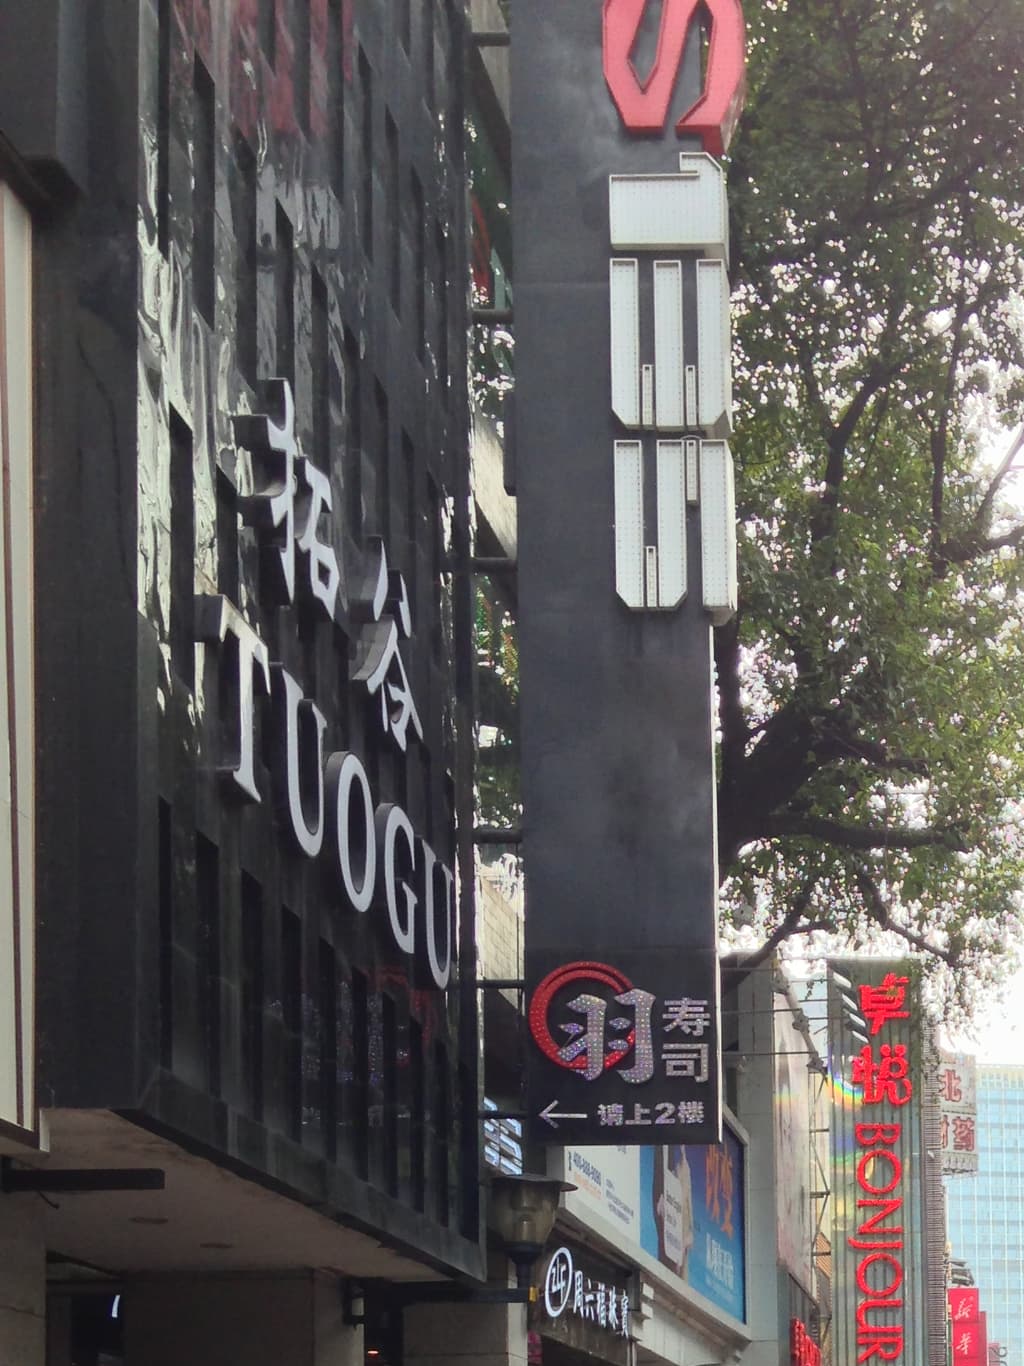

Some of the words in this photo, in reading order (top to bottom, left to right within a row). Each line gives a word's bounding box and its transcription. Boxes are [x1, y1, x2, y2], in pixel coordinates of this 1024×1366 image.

[212, 594, 456, 990] TUOGU
[556, 988, 657, 1085] 羽
[661, 997, 711, 1083] 寿司
[851, 972, 913, 1106] 卓悦
[847, 1122, 904, 1365] BONJOUR
